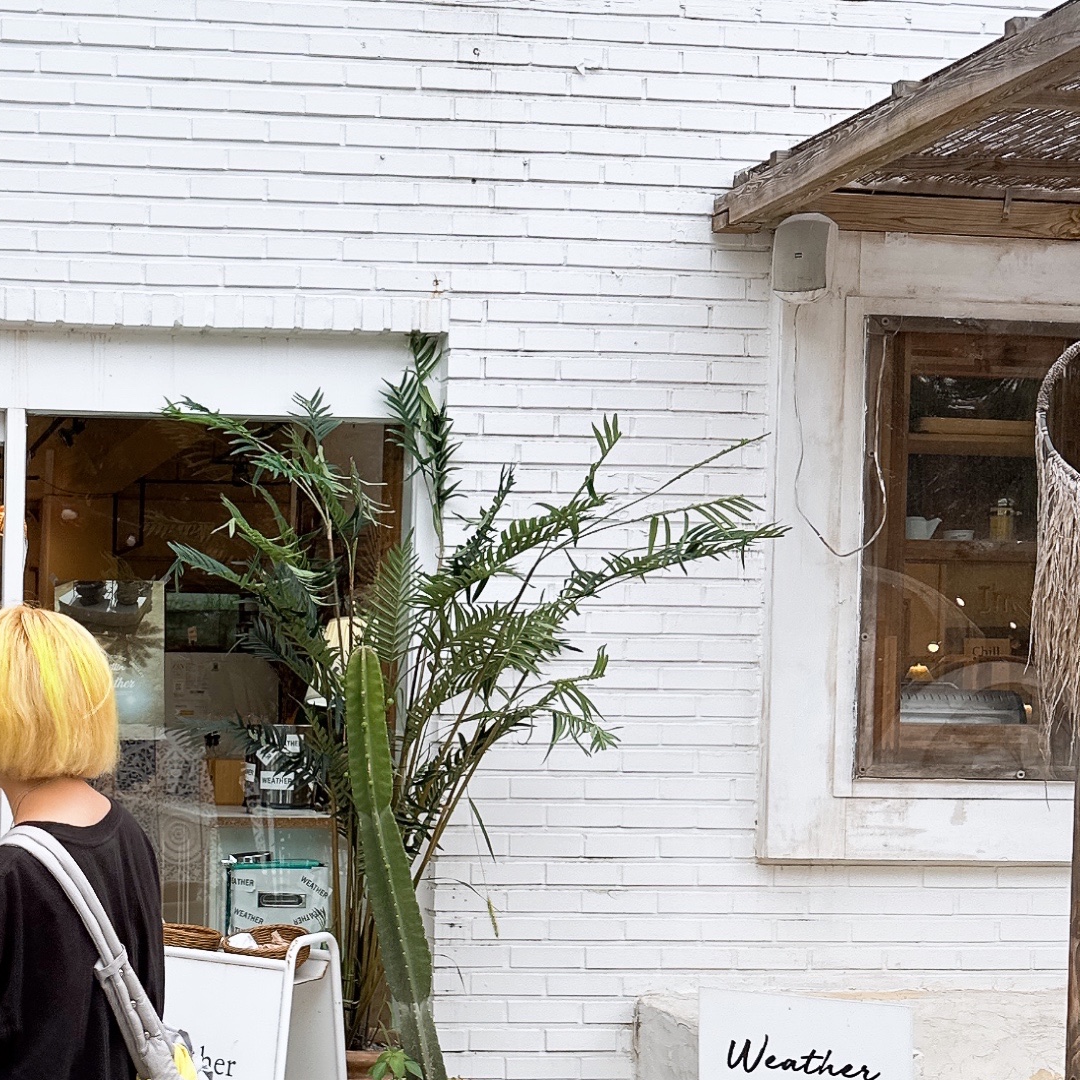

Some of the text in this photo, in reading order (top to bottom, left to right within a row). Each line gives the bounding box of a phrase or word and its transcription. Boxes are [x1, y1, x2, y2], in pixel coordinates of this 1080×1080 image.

[972, 644, 1000, 657] Chill
[114, 676, 136, 688] ther
[231, 877, 255, 887] EATHER
[300, 875, 329, 900] WEATHER
[233, 907, 264, 925] WEATHER
